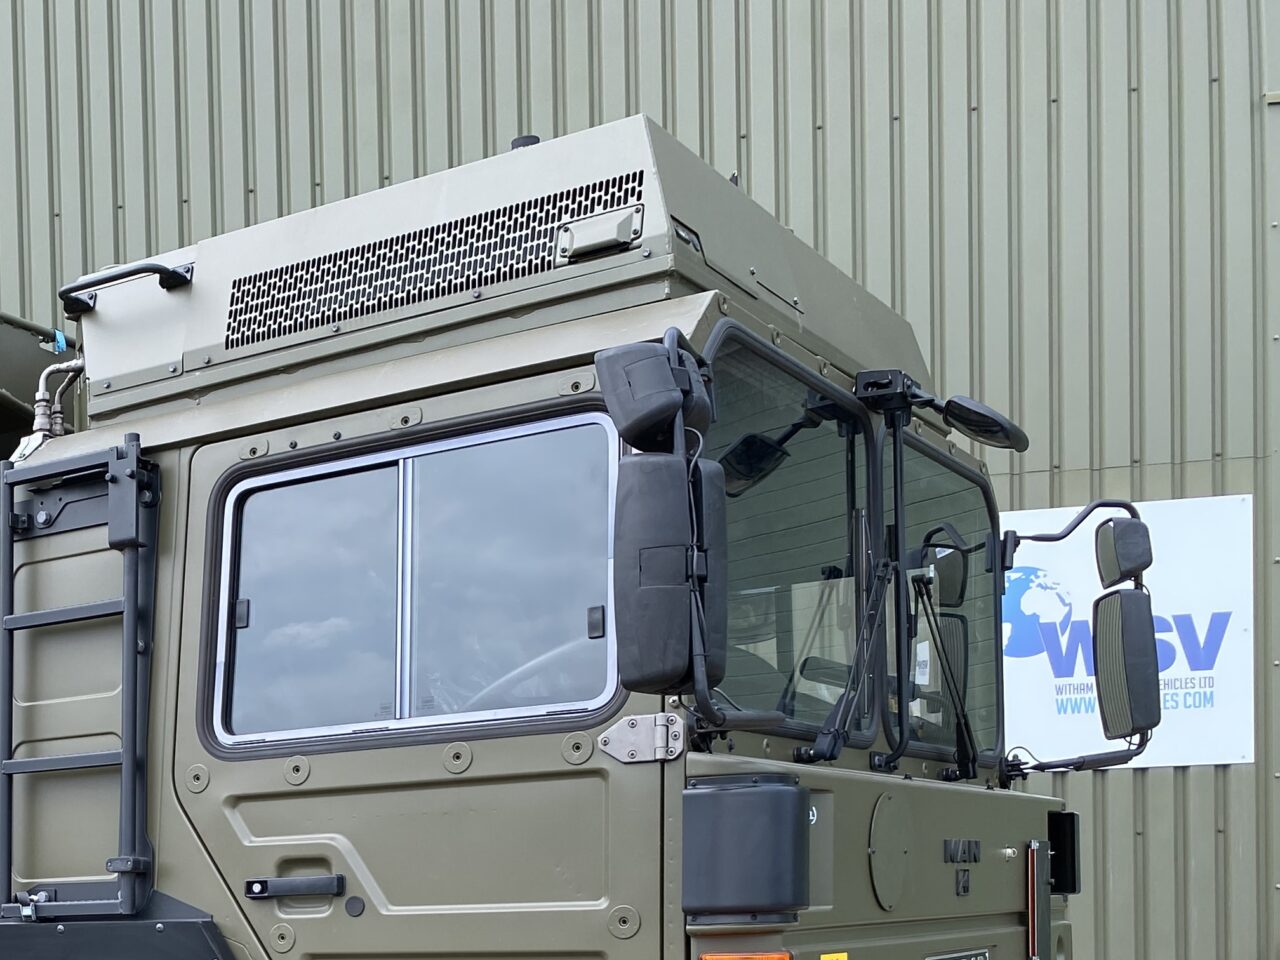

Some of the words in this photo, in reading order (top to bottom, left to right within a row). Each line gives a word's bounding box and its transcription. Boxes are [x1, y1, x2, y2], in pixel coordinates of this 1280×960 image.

[1055, 683, 1094, 696] WITHAM
[1198, 676, 1215, 689] LTD
[943, 838, 981, 864] MAN
